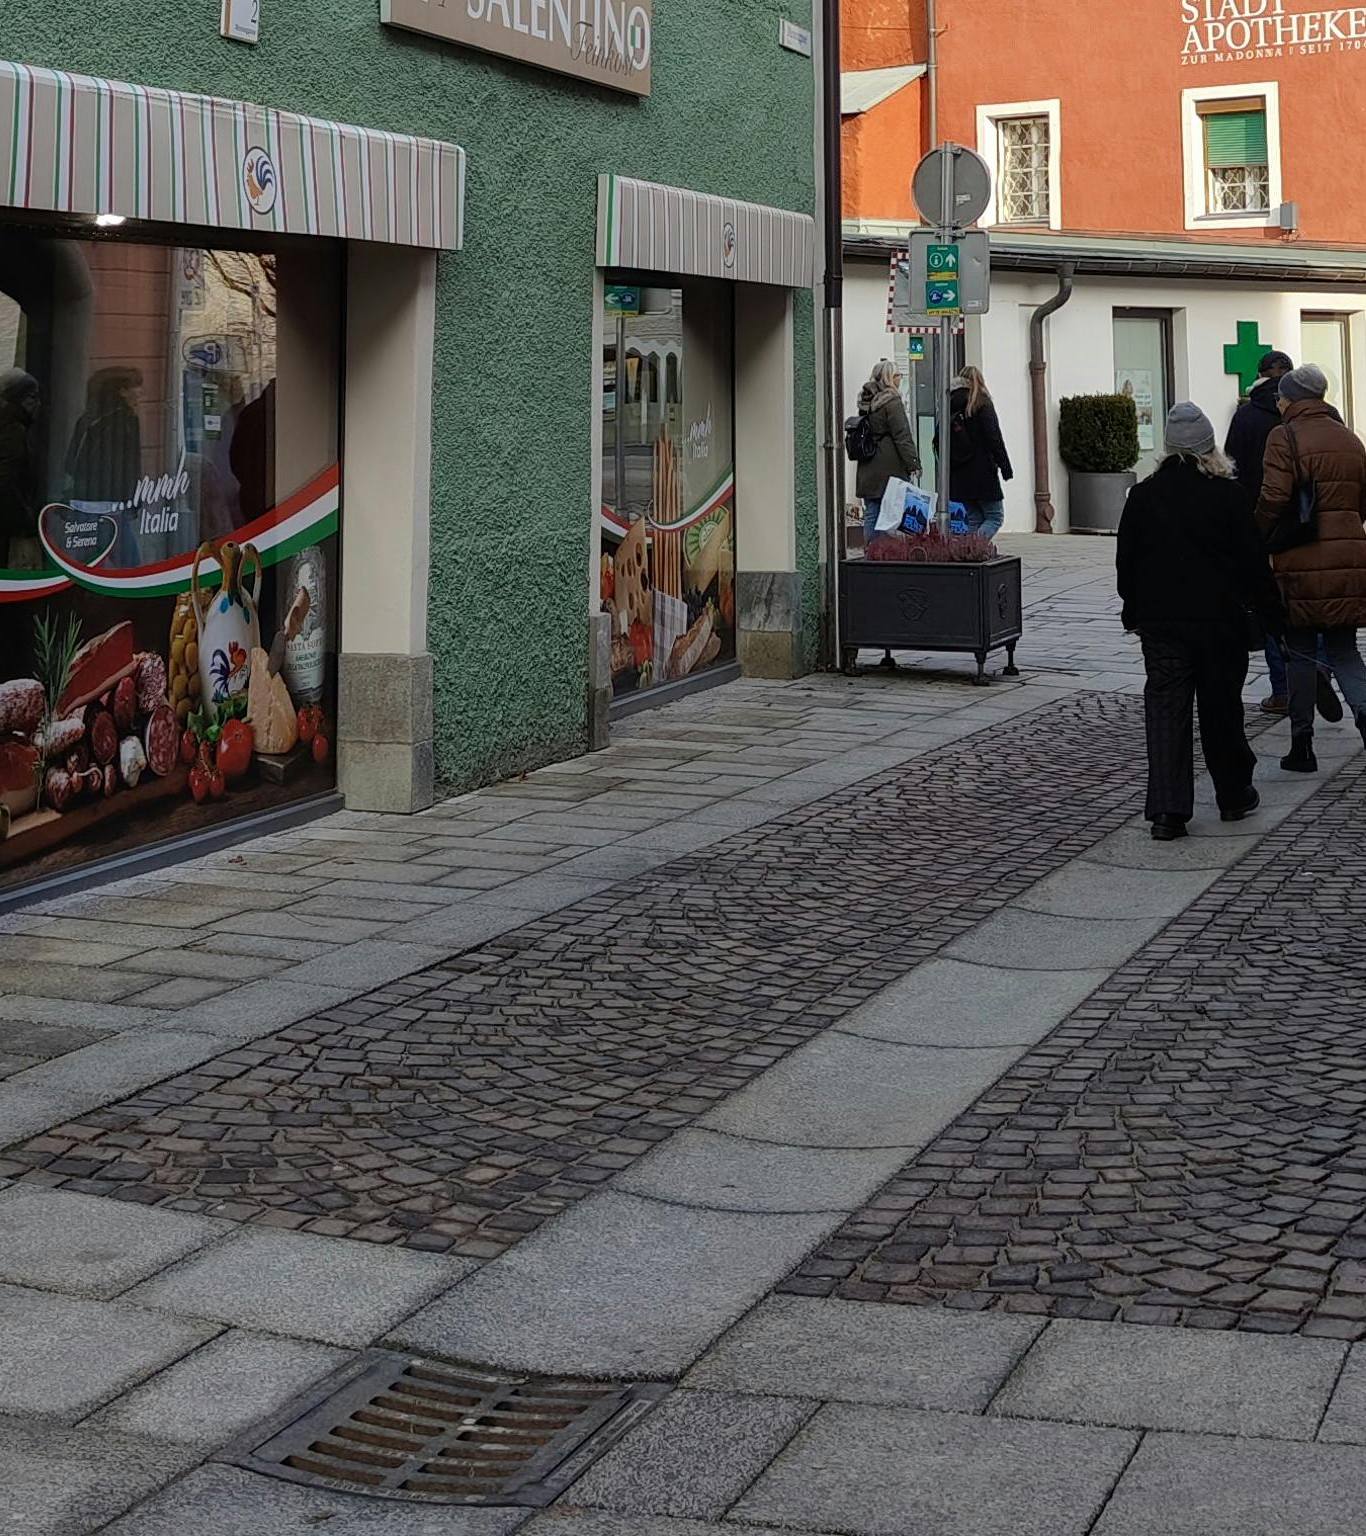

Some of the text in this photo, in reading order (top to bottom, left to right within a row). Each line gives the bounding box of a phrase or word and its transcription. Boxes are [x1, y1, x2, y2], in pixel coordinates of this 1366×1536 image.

[250, 0, 258, 24] 2
[1180, 52, 1209, 66] ZUR
[1214, 47, 1284, 63] MADONNA
[1299, 42, 1332, 56] SEIT
[64, 520, 98, 534] Salvatore
[139, 506, 180, 535] Italia
